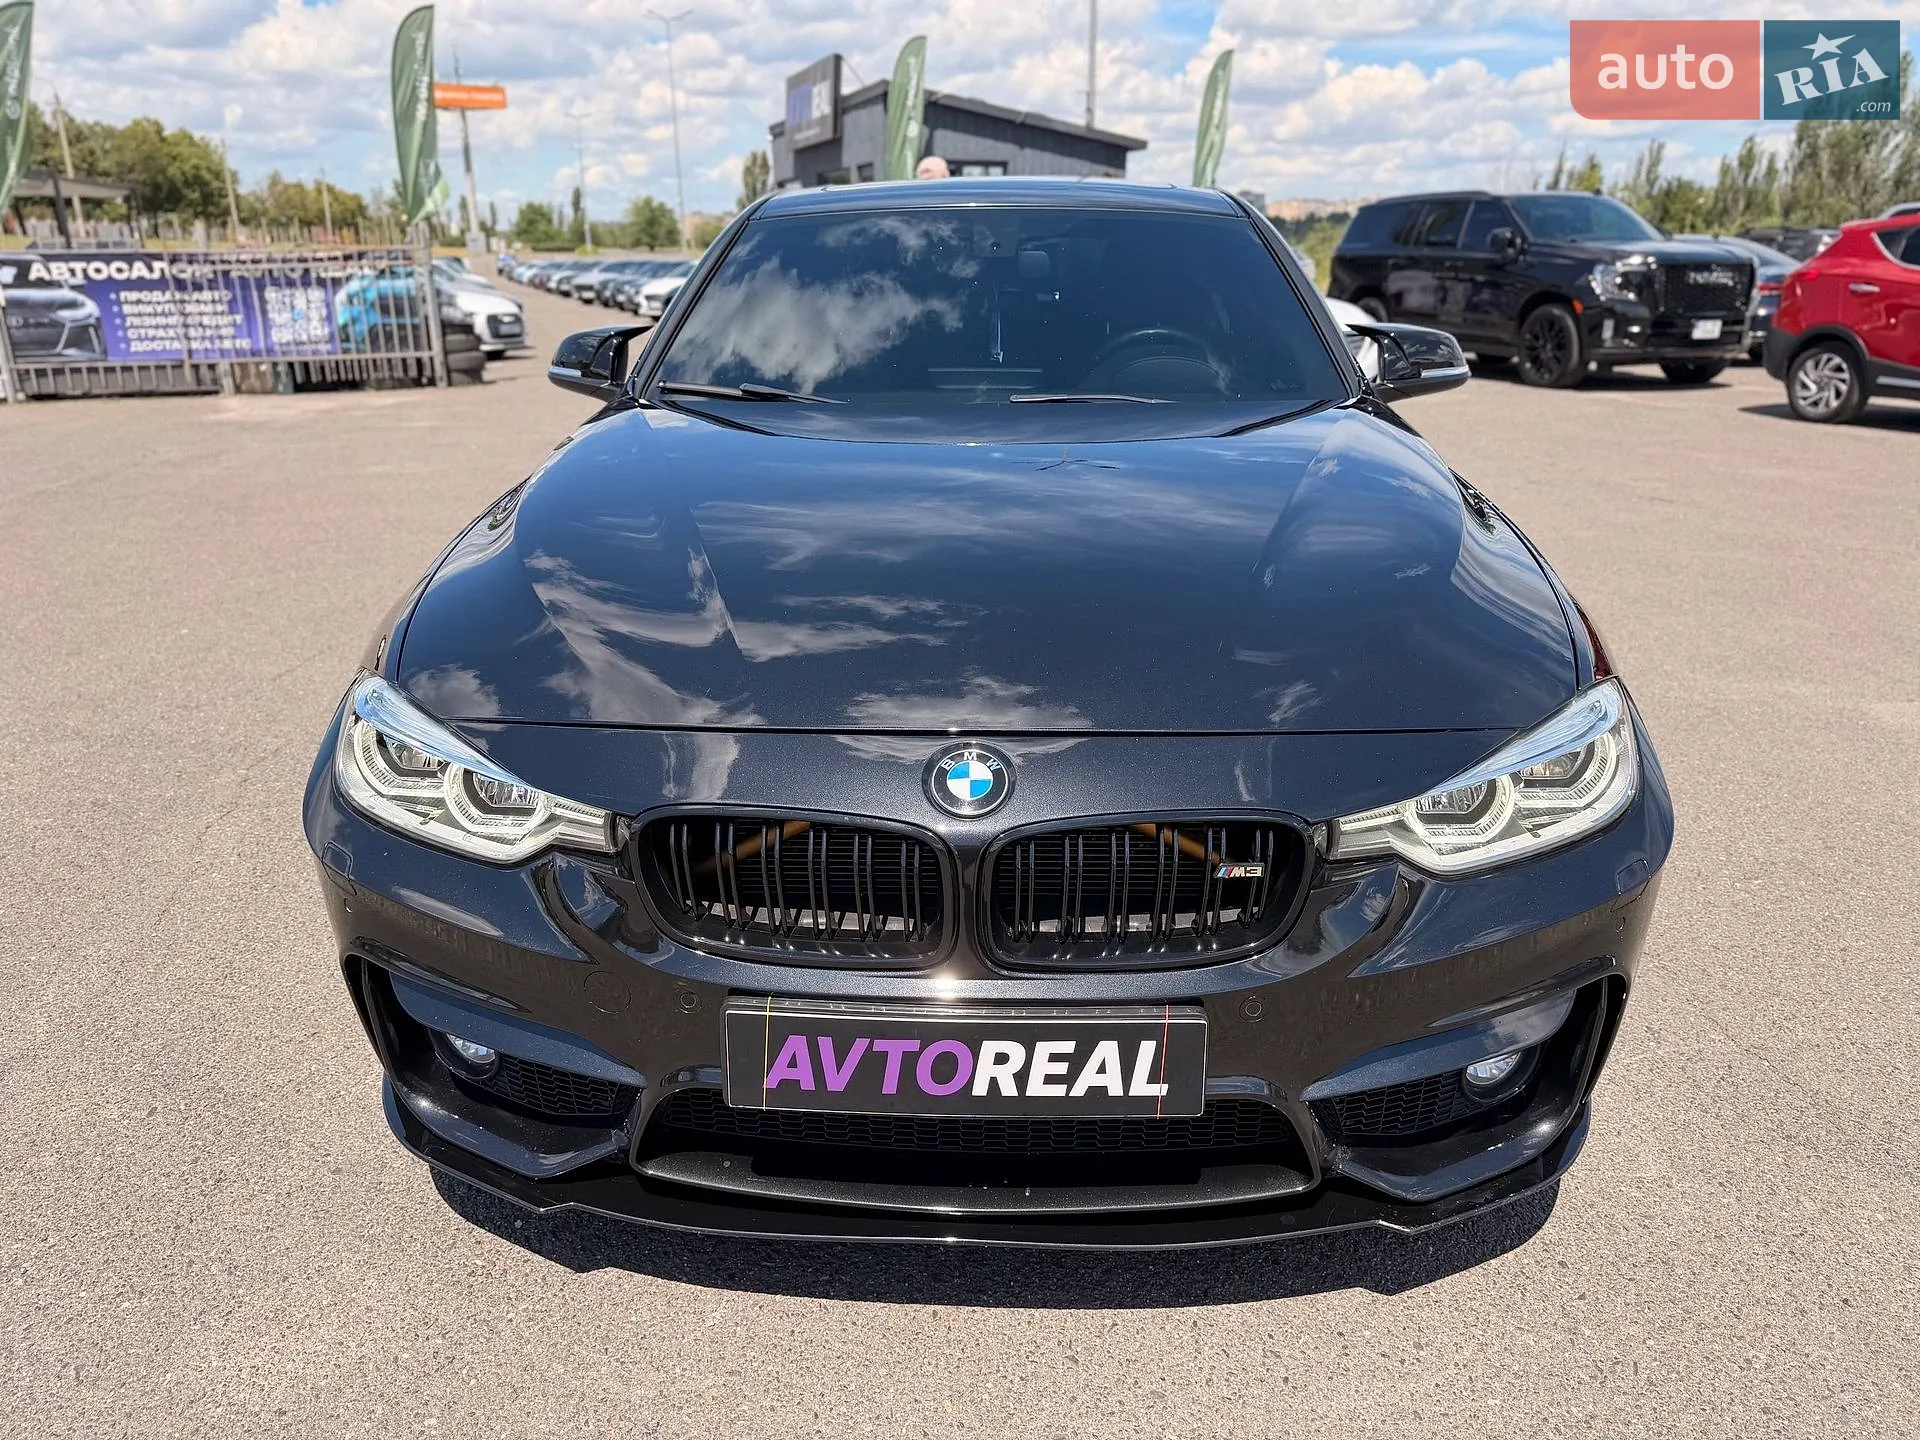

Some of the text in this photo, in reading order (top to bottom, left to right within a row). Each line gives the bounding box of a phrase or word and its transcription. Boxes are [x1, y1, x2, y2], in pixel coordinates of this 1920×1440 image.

[940, 751, 1001, 771] BMW
[1229, 866, 1263, 878] M3
[766, 1034, 1170, 1097] AVTOREAL
